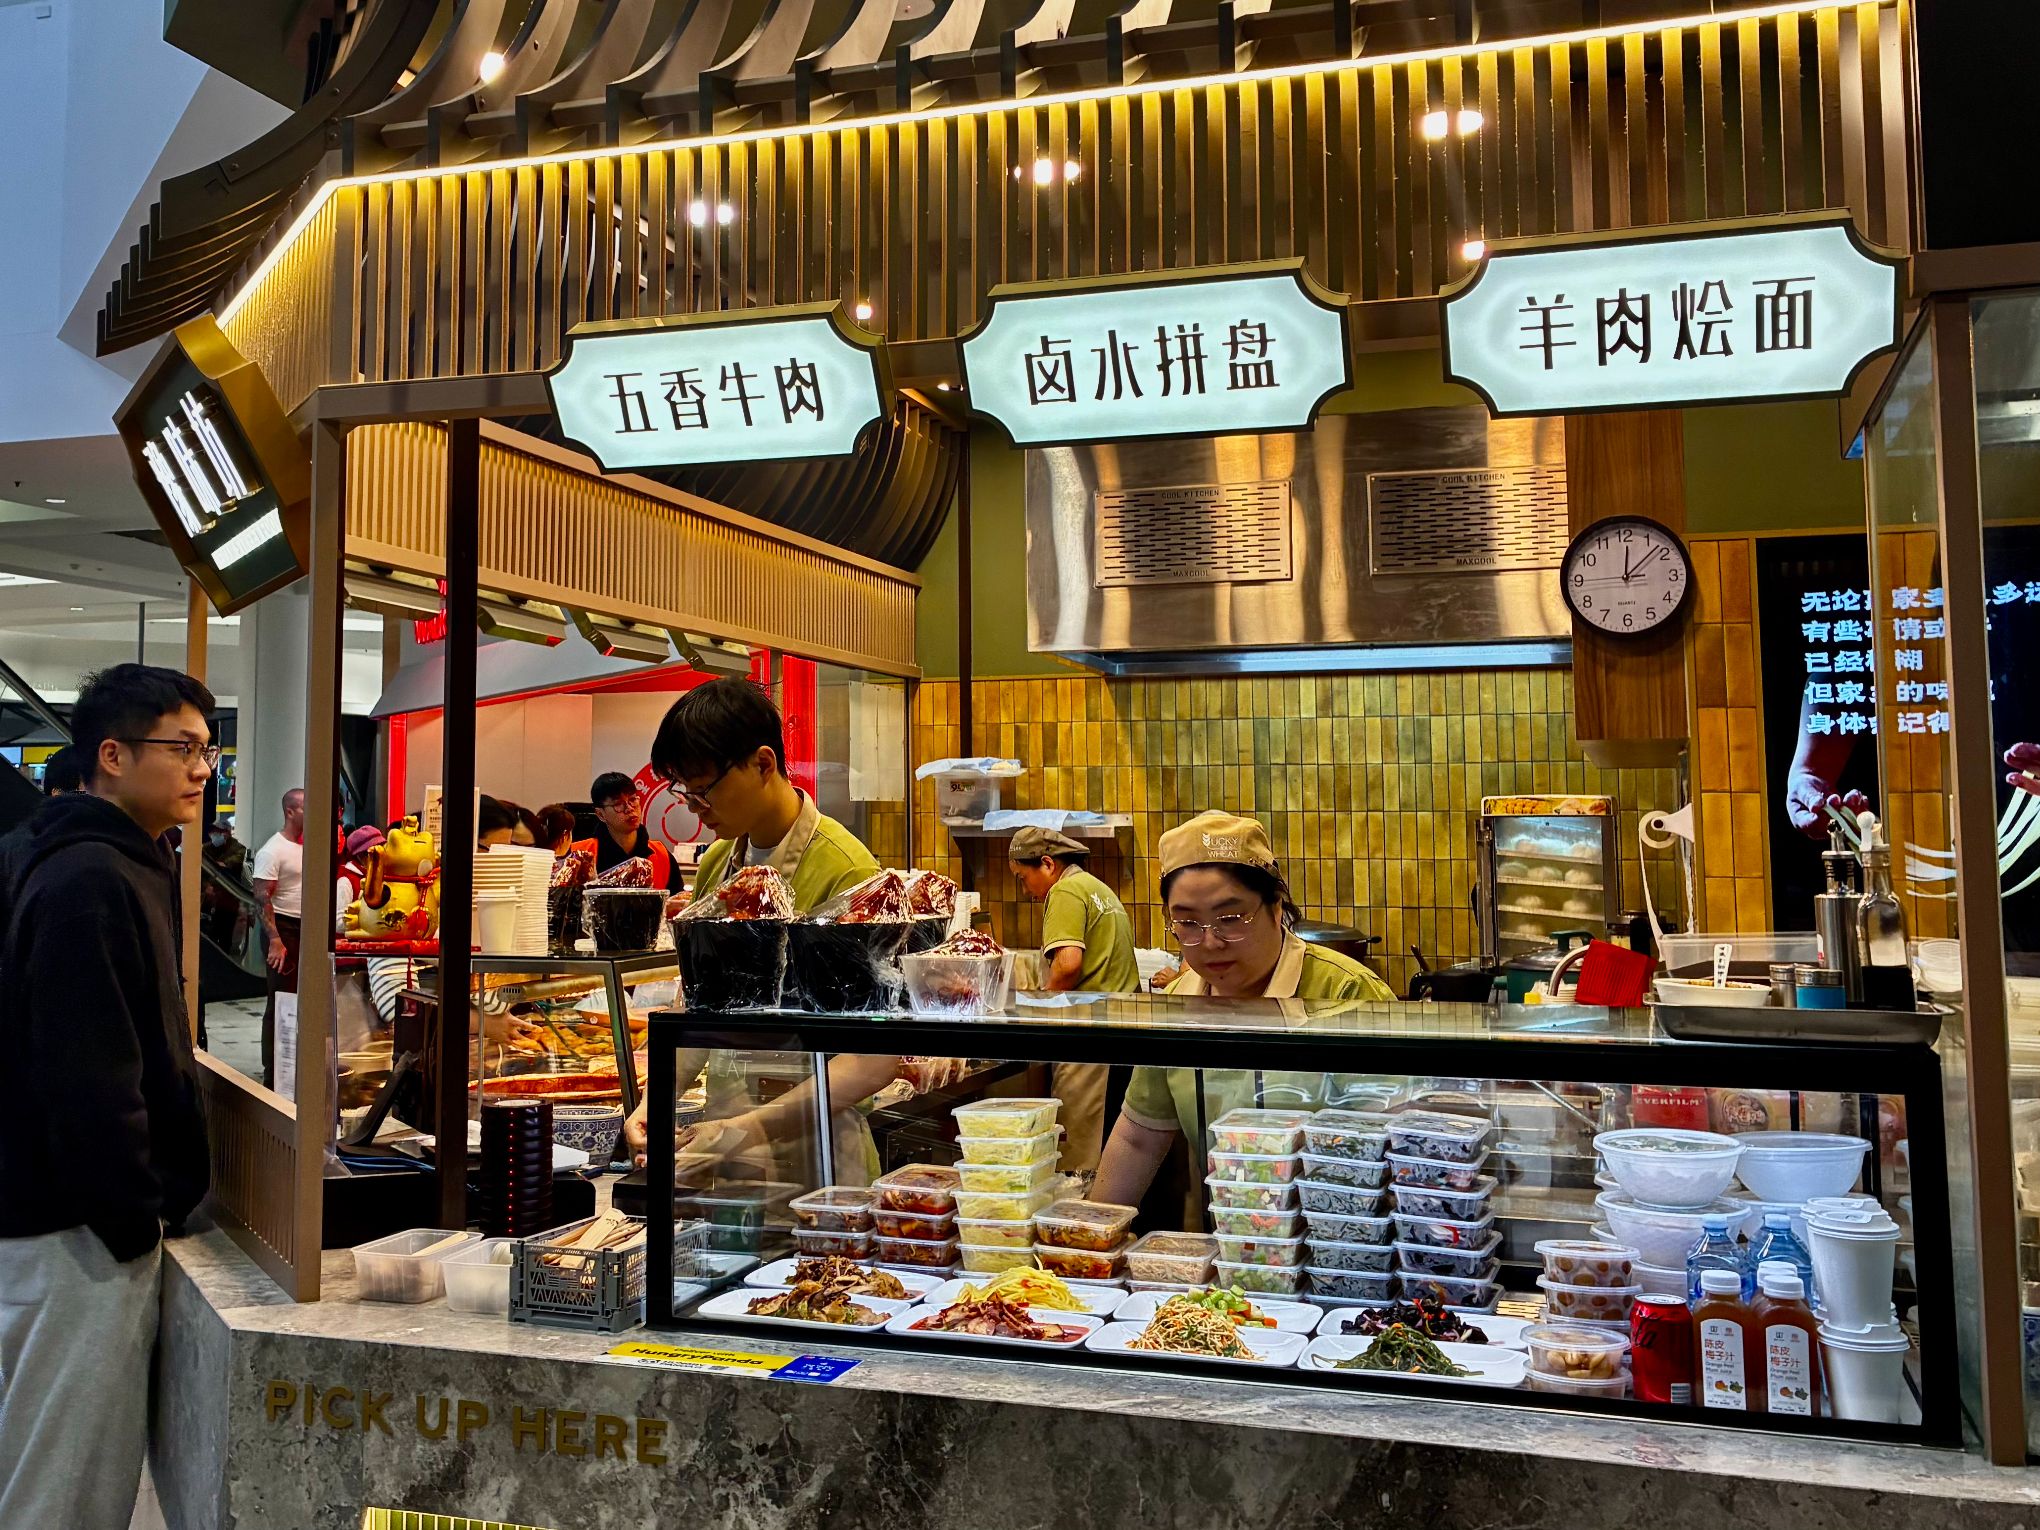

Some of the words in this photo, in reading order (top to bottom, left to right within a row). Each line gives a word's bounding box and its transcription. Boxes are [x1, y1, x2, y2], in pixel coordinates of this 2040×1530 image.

[1518, 276, 1816, 371] 羊肉烩面
[1024, 318, 1281, 406] 卤水拼盘
[603, 357, 825, 434] 五香牛肉
[1442, 475, 1464, 484] COOL
[1467, 473, 1505, 483] KITCHEN
[1161, 490, 1181, 499] COOL
[1184, 489, 1219, 498] KITCHEN
[1615, 529, 1633, 543] 12
[1643, 533, 1650, 547] 1
[1595, 537, 1609, 550] 11
[1580, 553, 1597, 567] 10
[1659, 547, 1670, 560] 2
[1456, 557, 1497, 566] MAXCOOL
[1173, 569, 1209, 577] MAXCOOL
[1668, 568, 1679, 582] 3
[1573, 574, 1584, 587] 9
[1582, 595, 1592, 609] 8
[1662, 590, 1673, 604] 4
[1801, 580, 2040, 613] 无论家多多
[1599, 609, 1610, 622] 7
[1622, 613, 1633, 627] 6
[1645, 607, 1656, 620] 5
[1207, 850, 1239, 858] WHEAT
[632, 1348, 765, 1366] HungryPanda
[265, 1379, 394, 1436] PICK
[416, 1393, 489, 1442] UP
[512, 1405, 668, 1466] HERE
